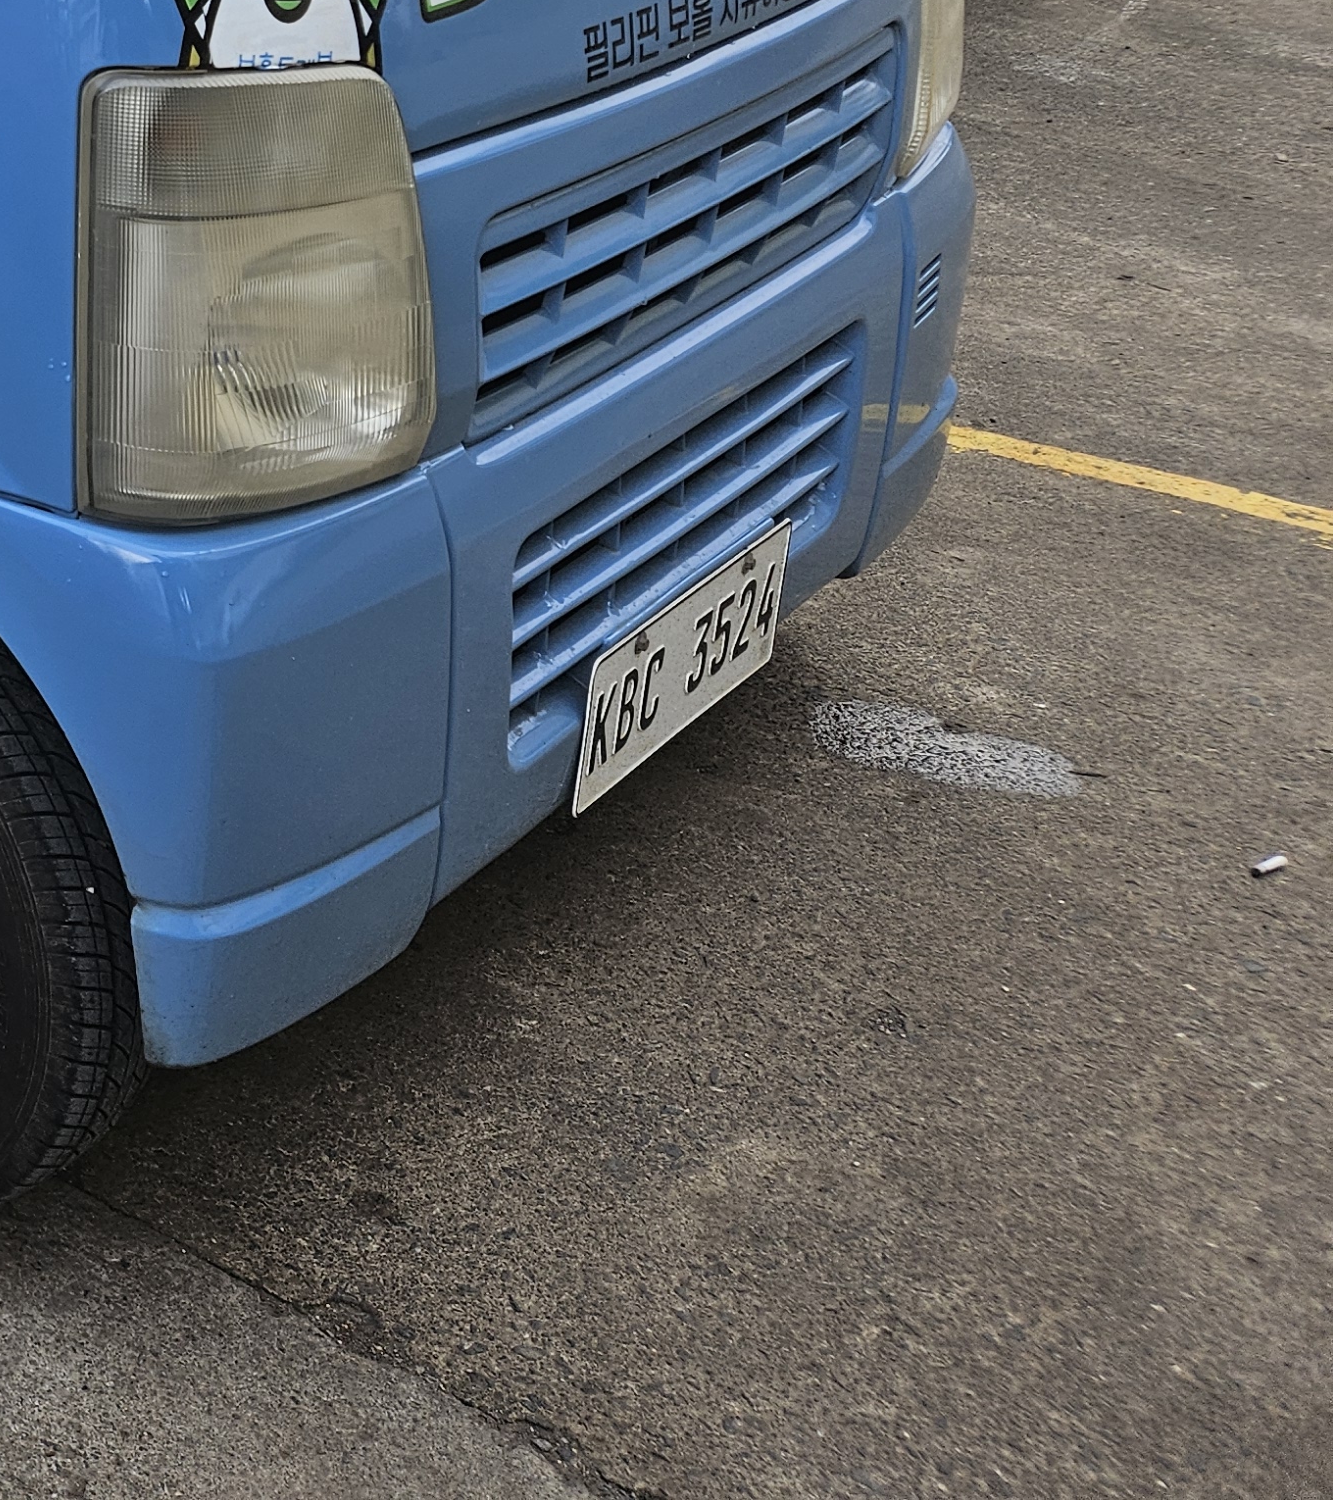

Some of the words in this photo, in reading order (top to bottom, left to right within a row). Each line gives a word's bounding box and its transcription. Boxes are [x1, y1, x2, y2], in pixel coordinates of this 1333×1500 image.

[583, 3, 660, 84] 필리핀
[585, 643, 666, 777] KBC
[684, 561, 776, 695] 3524
